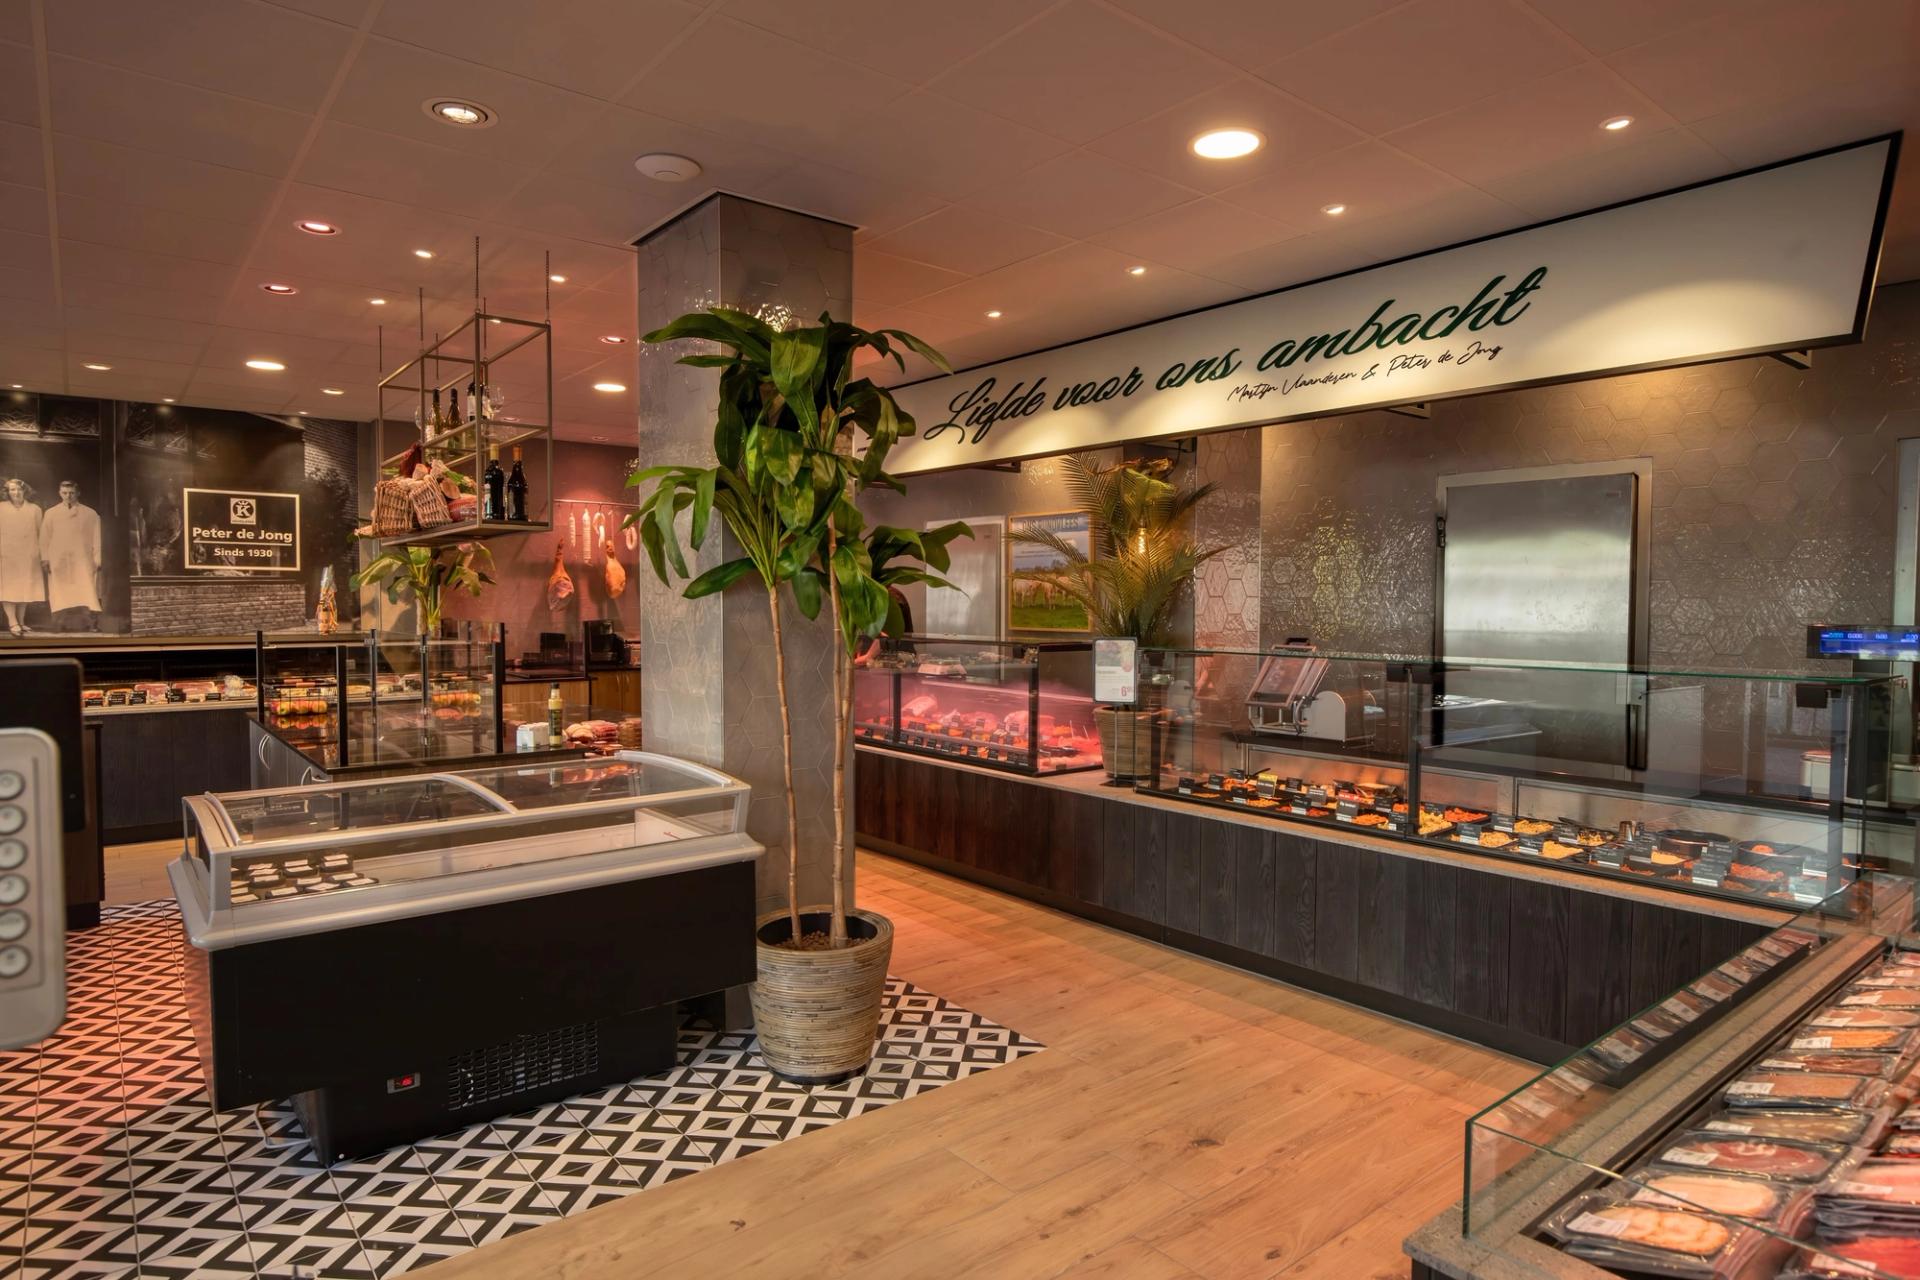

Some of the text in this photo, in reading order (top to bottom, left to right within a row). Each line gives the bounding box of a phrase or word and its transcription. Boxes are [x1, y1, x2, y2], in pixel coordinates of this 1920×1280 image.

[923, 265, 1549, 445] Liefde voor ons ambacht
[1281, 371, 1358, 396] Vlaanderen
[1361, 363, 1380, 381] &
[1386, 354, 1433, 377] Peter
[1437, 349, 1454, 364] de
[1456, 340, 1504, 366] Jong
[192, 527, 293, 543] Peter de Jong
[213, 547, 273, 558] Sinds 1930
